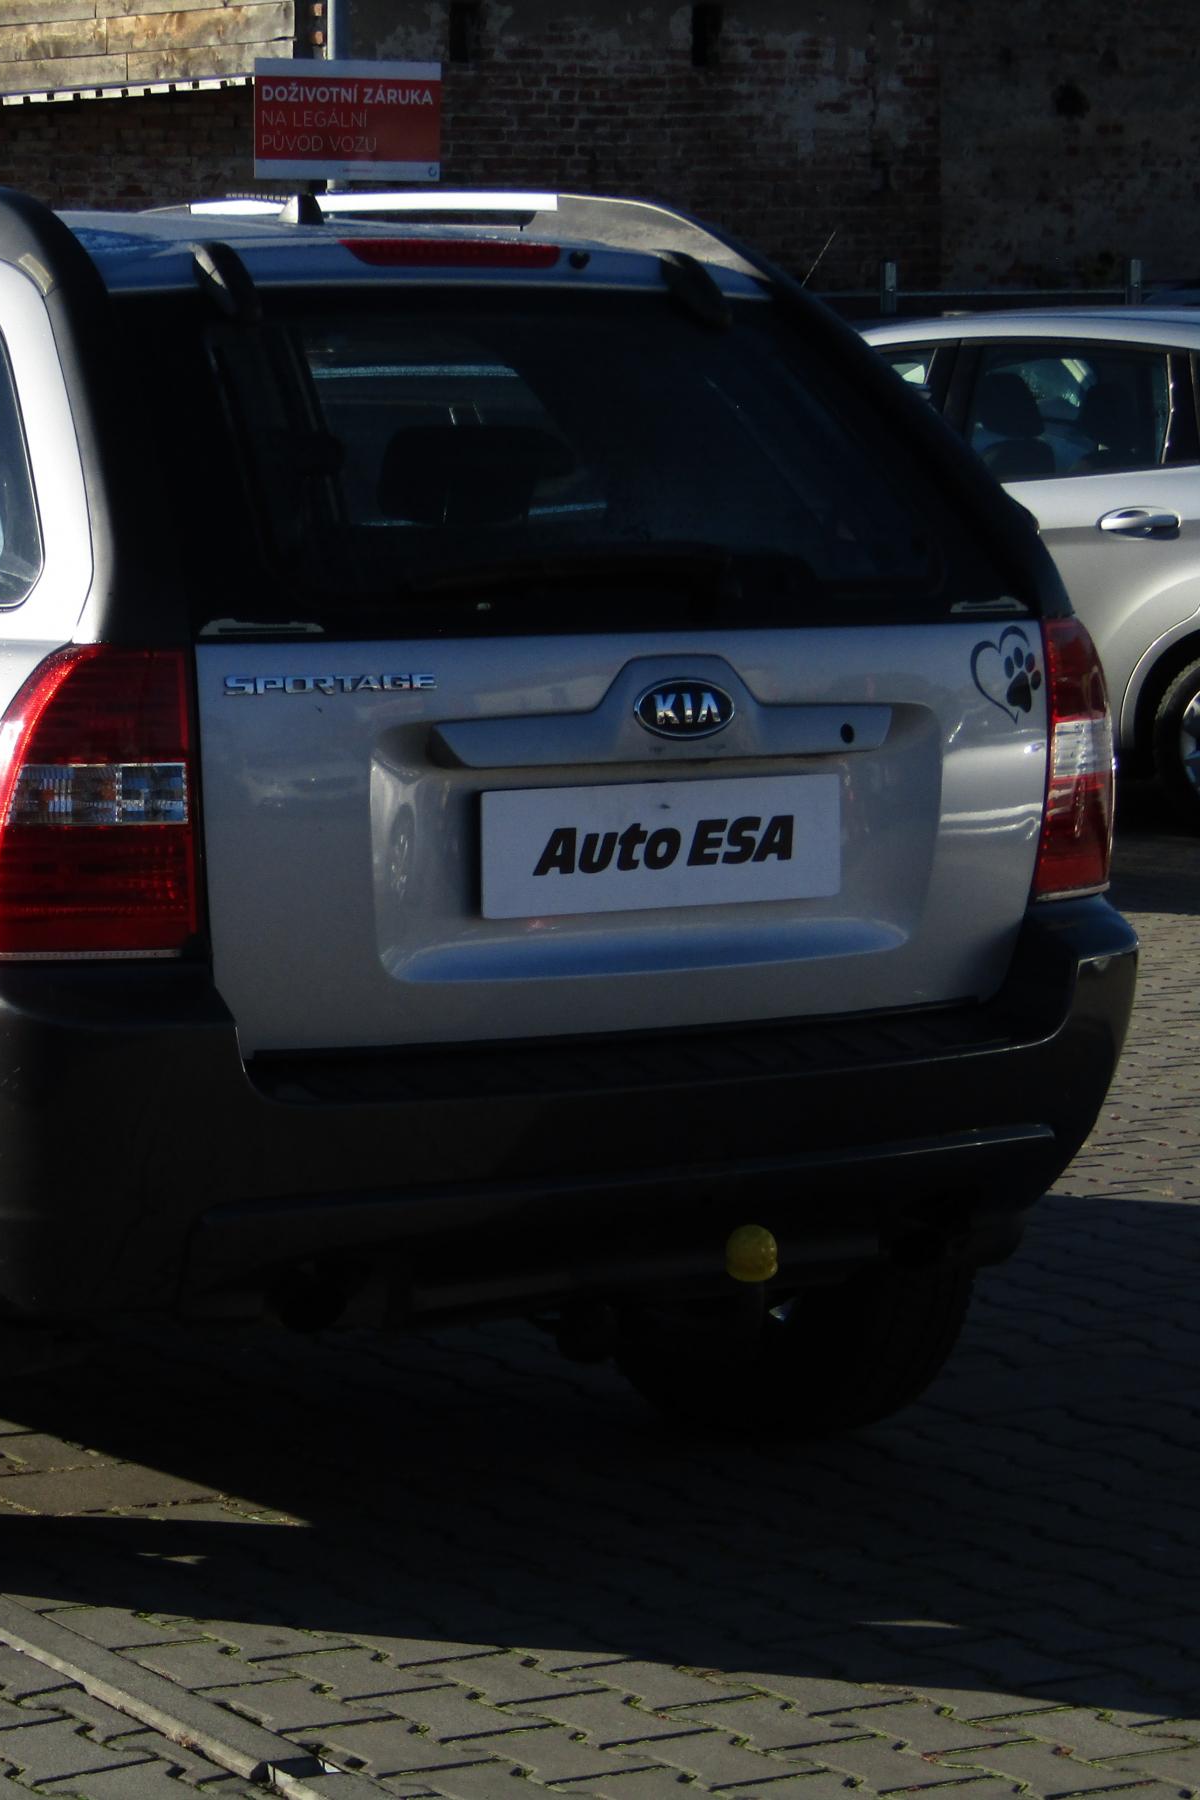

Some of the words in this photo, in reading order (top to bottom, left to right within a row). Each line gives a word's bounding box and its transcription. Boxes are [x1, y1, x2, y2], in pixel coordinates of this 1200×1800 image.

[362, 84, 434, 106] ZÁRUKA
[261, 111, 287, 127] NA
[329, 136, 378, 154] VOZU
[224, 672, 438, 696] SPORTAGE
[653, 692, 722, 726] KIA
[533, 823, 682, 877] Auto
[686, 814, 795, 868] ESA
